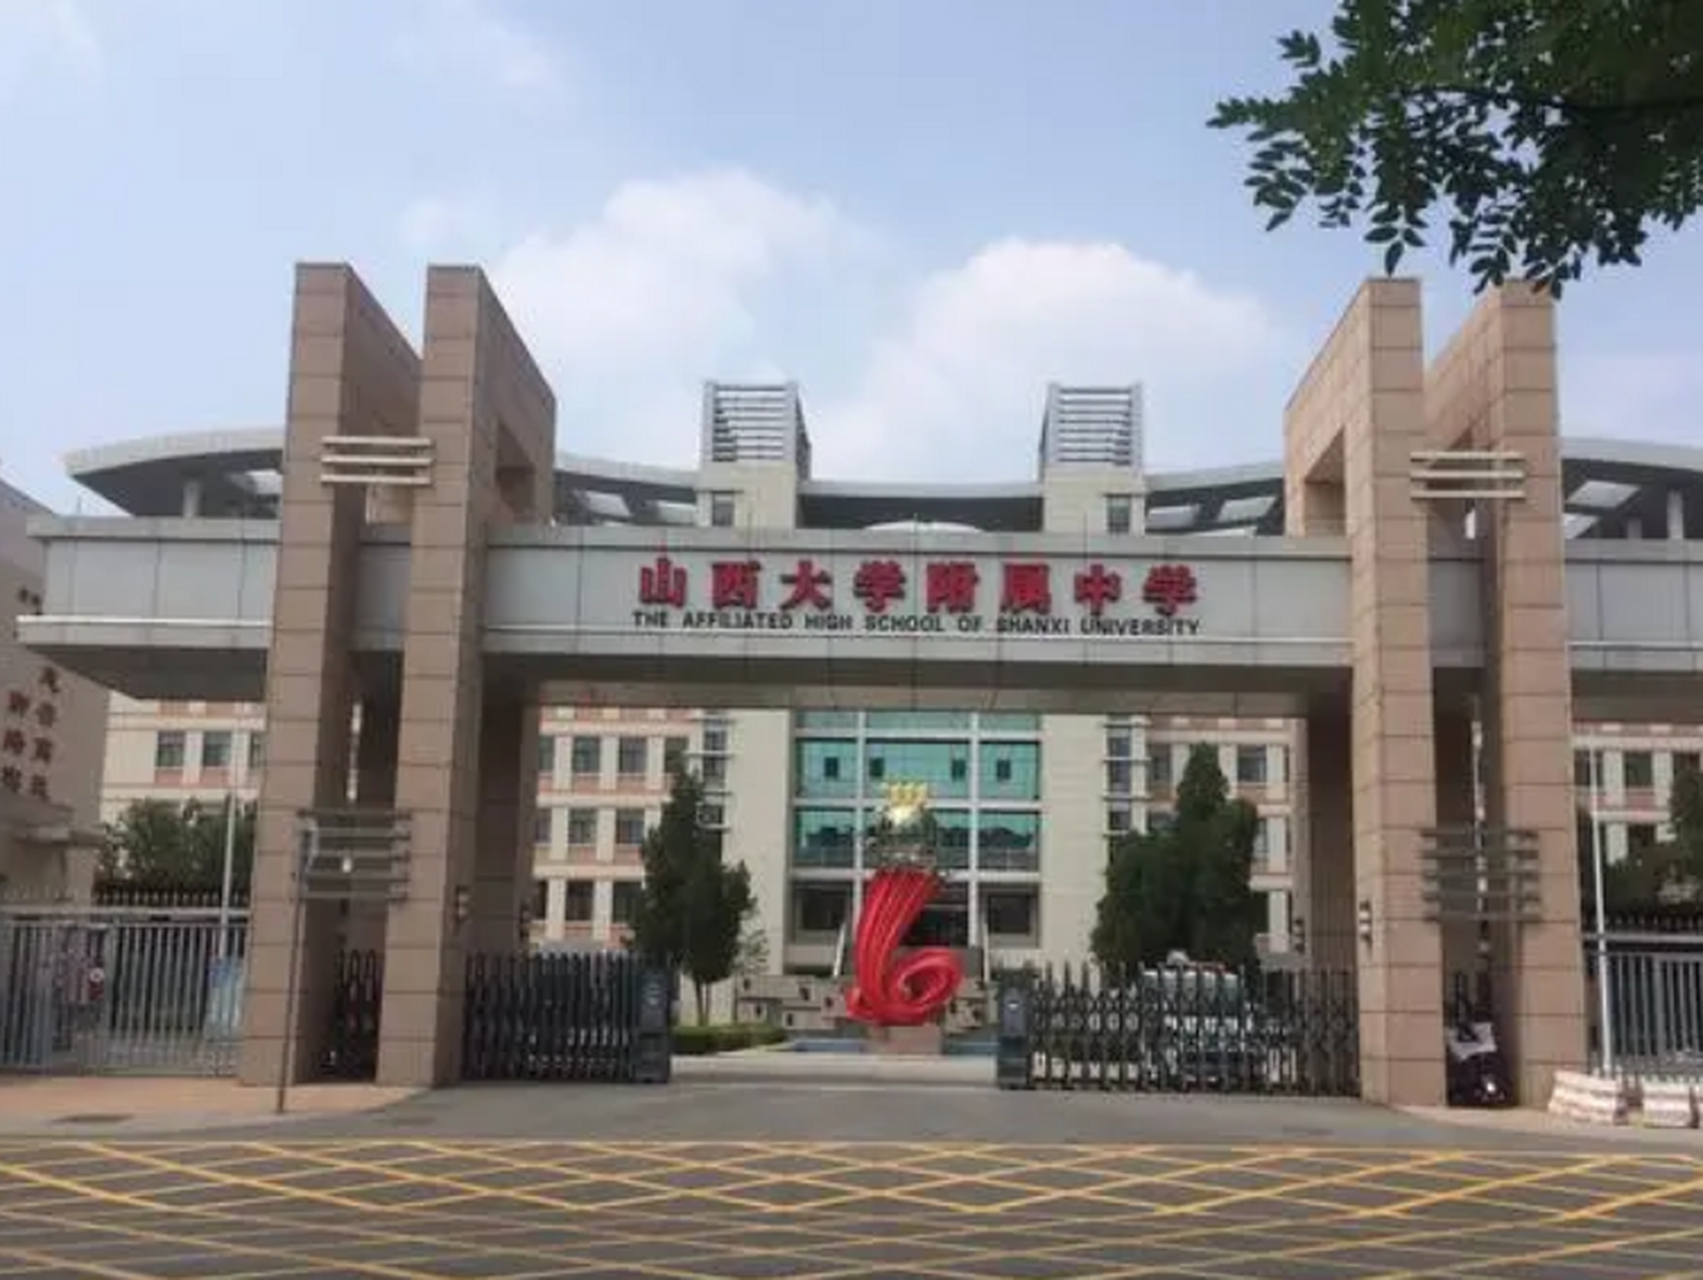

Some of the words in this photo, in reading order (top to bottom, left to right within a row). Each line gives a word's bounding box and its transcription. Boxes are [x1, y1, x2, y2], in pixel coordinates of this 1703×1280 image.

[638, 556, 1198, 617] 山西大学附属中学
[632, 611, 669, 628] THE
[682, 612, 793, 630] AFFILIATED
[804, 614, 852, 631] HIGH
[865, 615, 945, 632] SCHOOL
[957, 616, 984, 632] OF
[996, 617, 1070, 634] SHANXI
[1080, 618, 1200, 636] UNIVERSITY
